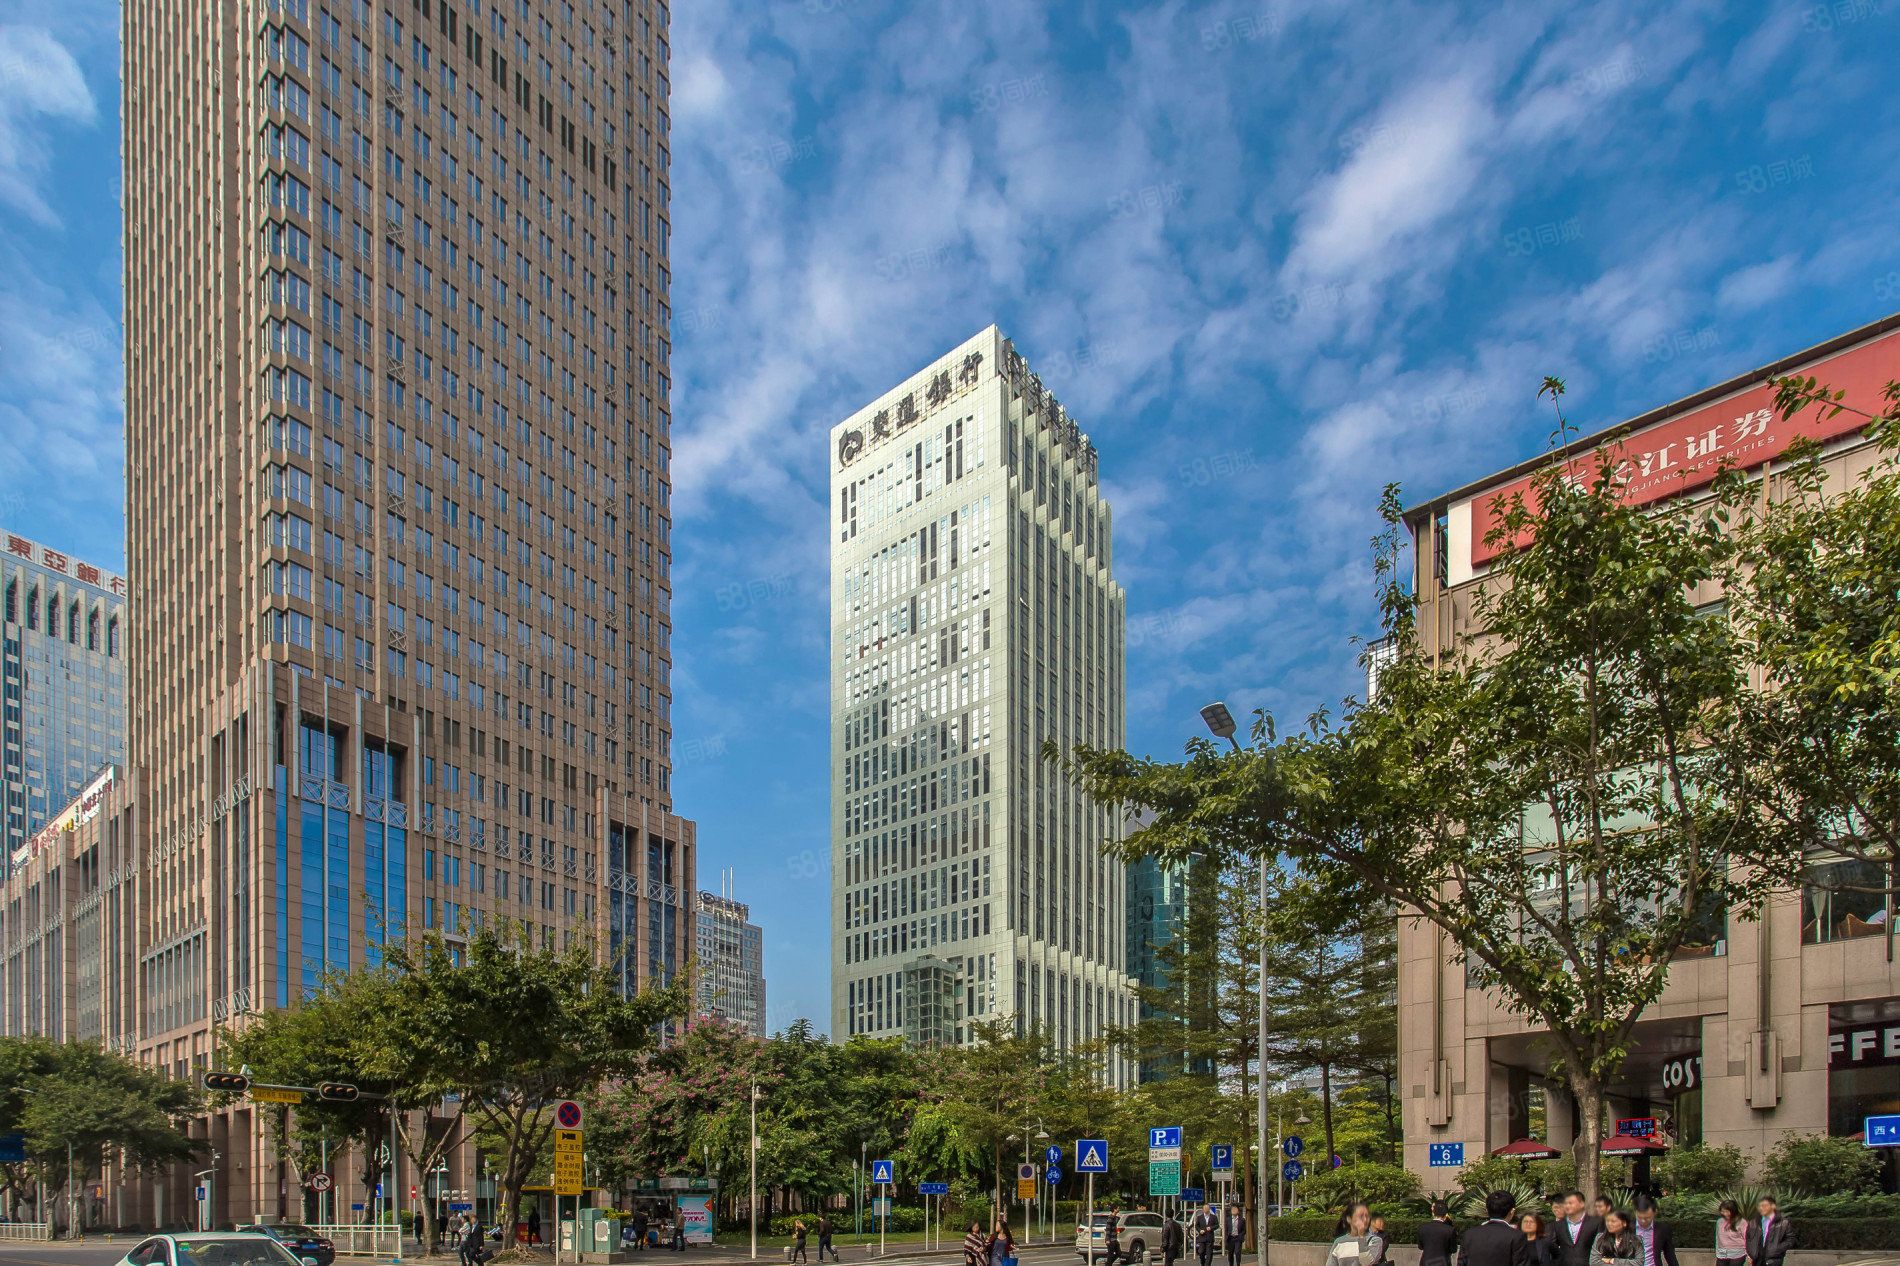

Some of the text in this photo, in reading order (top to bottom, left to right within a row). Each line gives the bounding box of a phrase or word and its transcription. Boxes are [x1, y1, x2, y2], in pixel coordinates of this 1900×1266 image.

[1873, 1125, 1887, 1136] 西
[1154, 1130, 1166, 1145] P
[1217, 1148, 1227, 1165] P
[1442, 1150, 1450, 1160] 6
